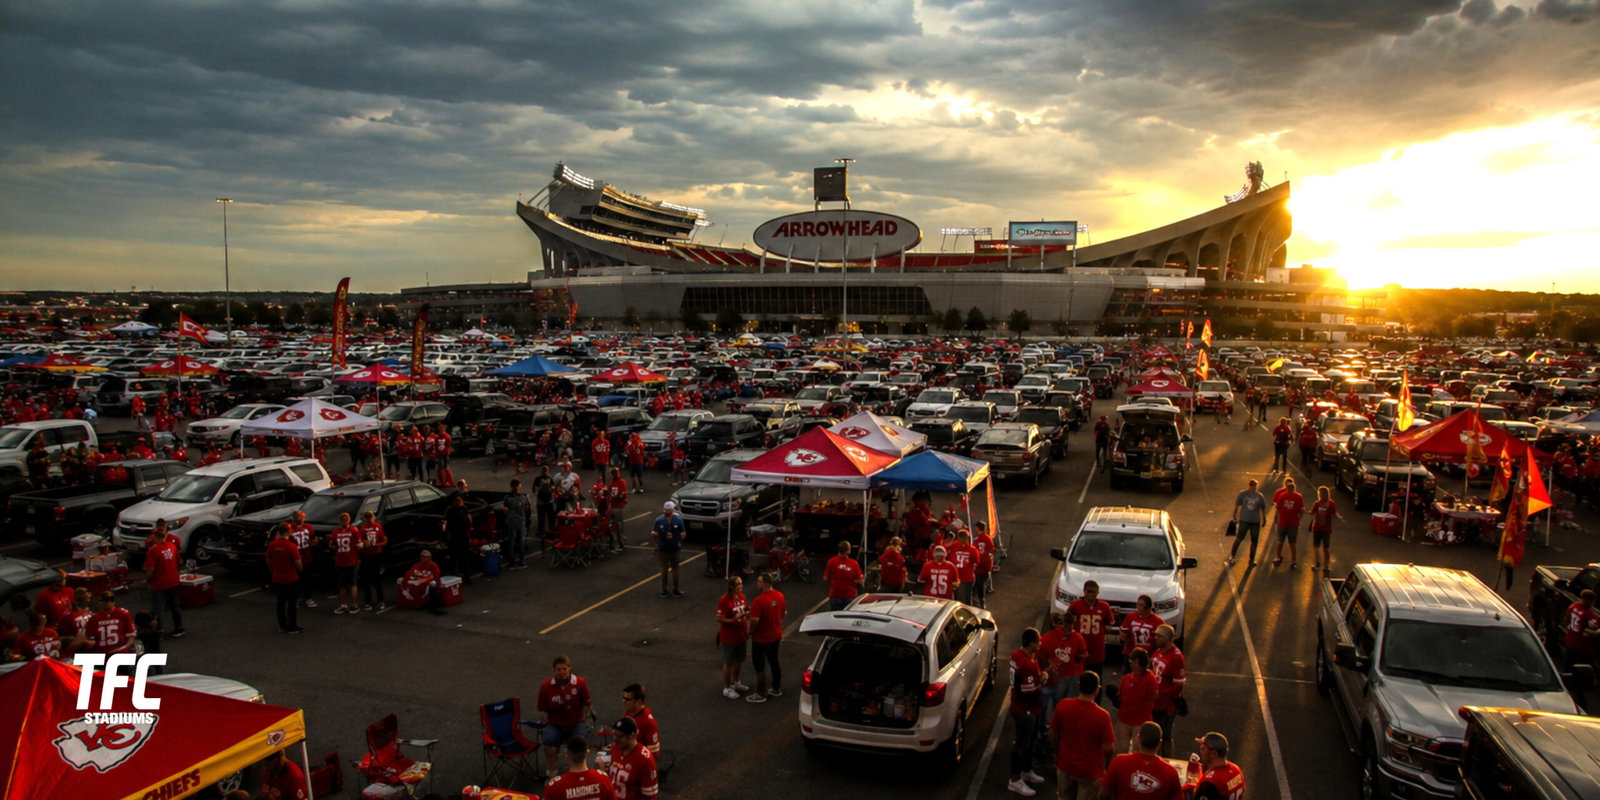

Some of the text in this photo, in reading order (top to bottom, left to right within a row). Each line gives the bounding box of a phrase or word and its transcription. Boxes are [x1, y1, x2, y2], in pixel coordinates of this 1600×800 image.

[772, 220, 898, 238] ARROWHEAD
[98, 624, 119, 647] 15
[566, 784, 601, 799] MAHOMES
